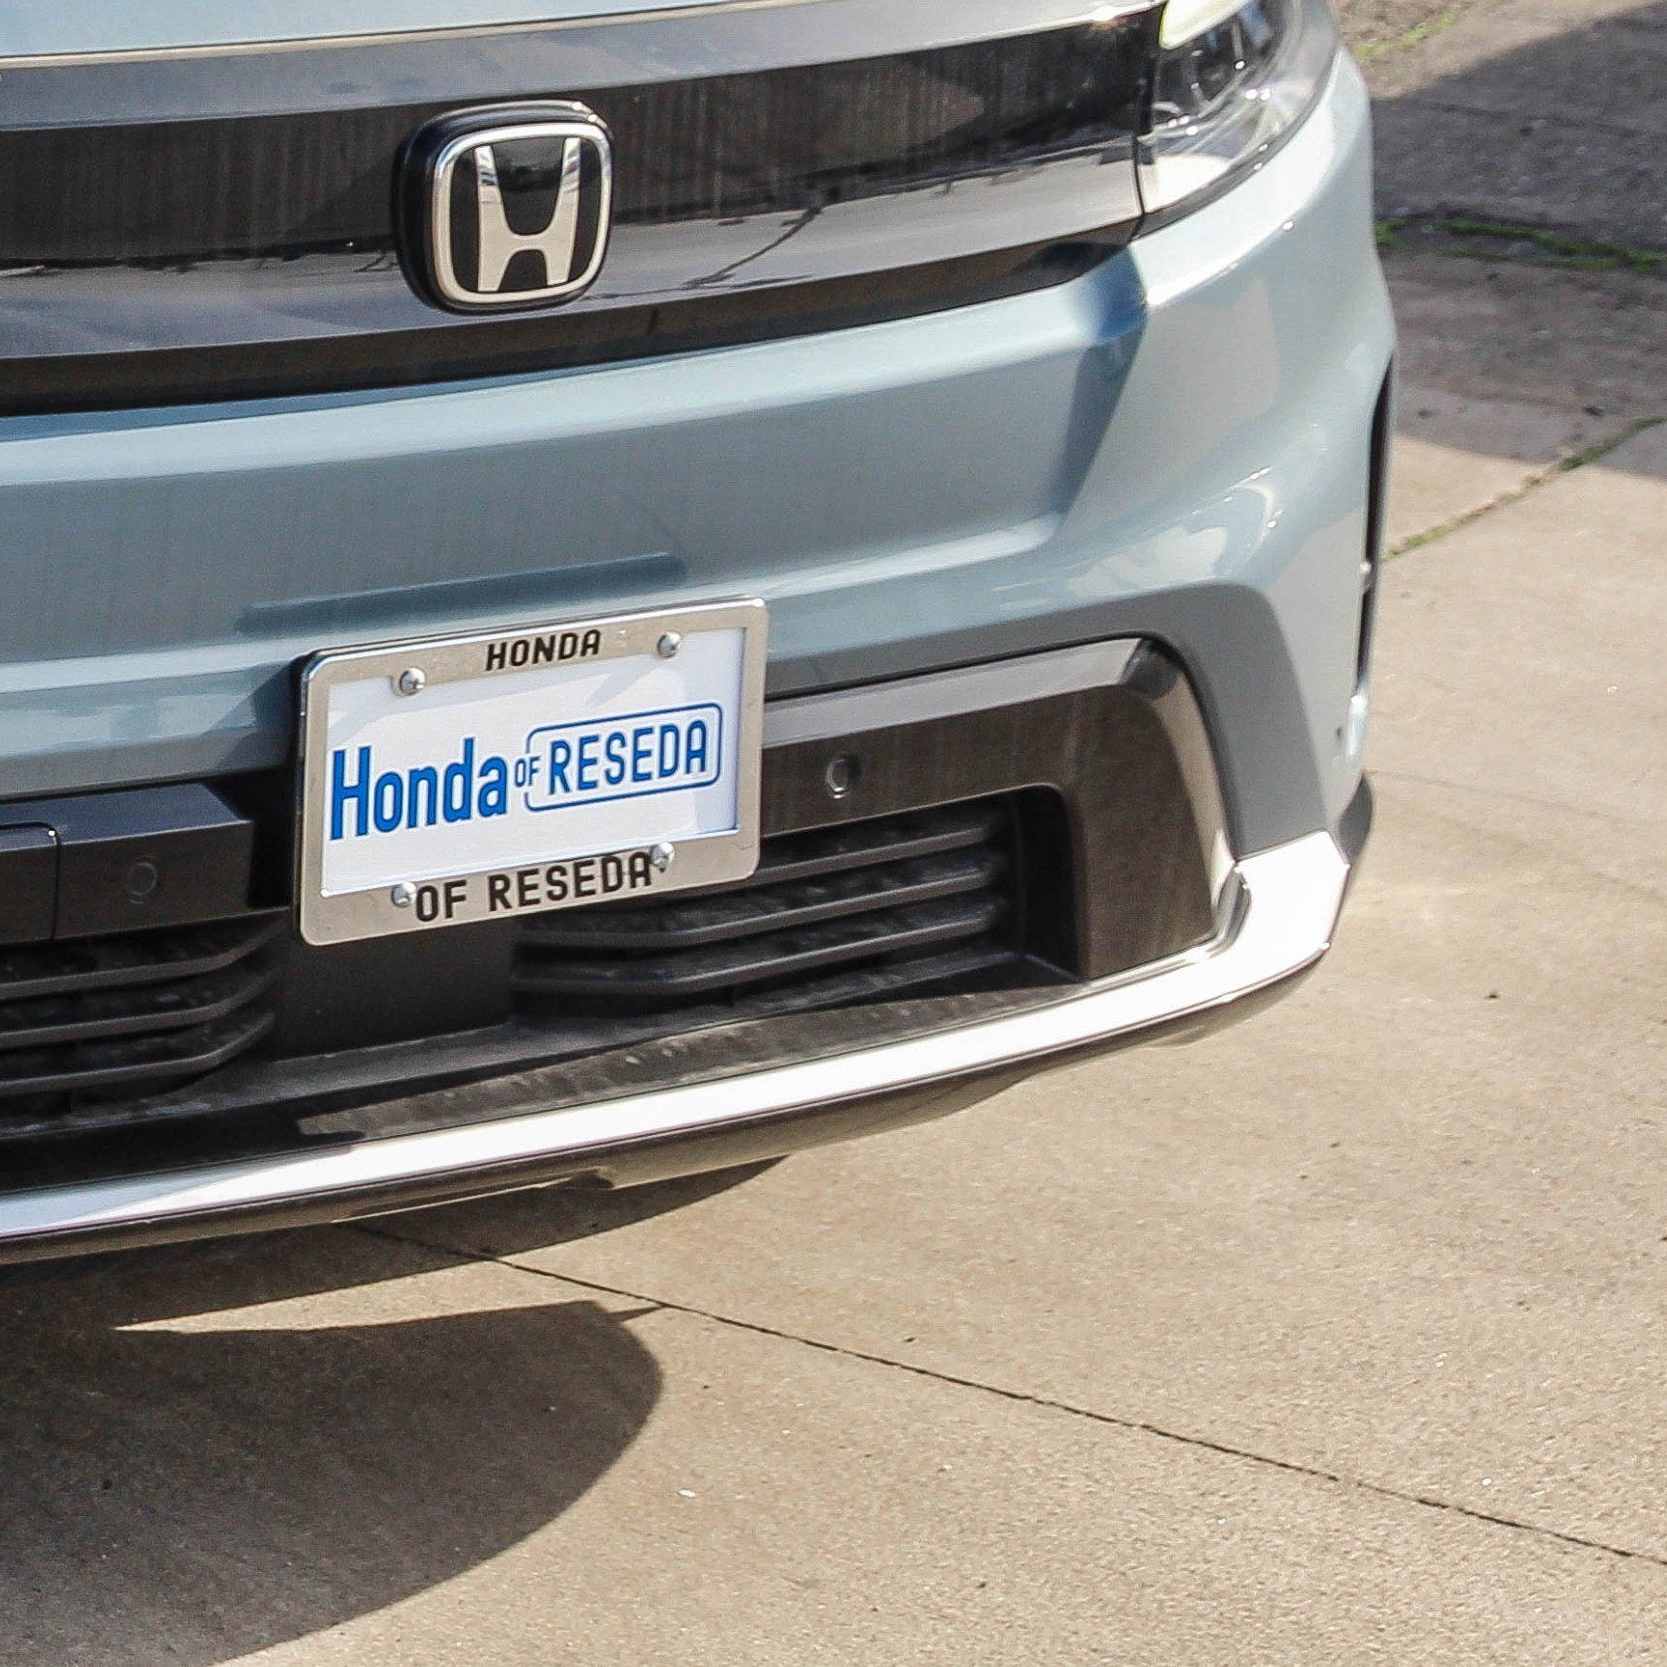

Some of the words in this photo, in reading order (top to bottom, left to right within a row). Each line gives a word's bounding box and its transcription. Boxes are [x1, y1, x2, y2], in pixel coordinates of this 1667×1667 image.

[483, 629, 601, 672] HONDA
[330, 736, 508, 841] Honda
[514, 753, 540, 788] OF
[547, 719, 708, 795] RESEDA
[415, 880, 467, 923] OF
[488, 851, 653, 912] RESEDA
